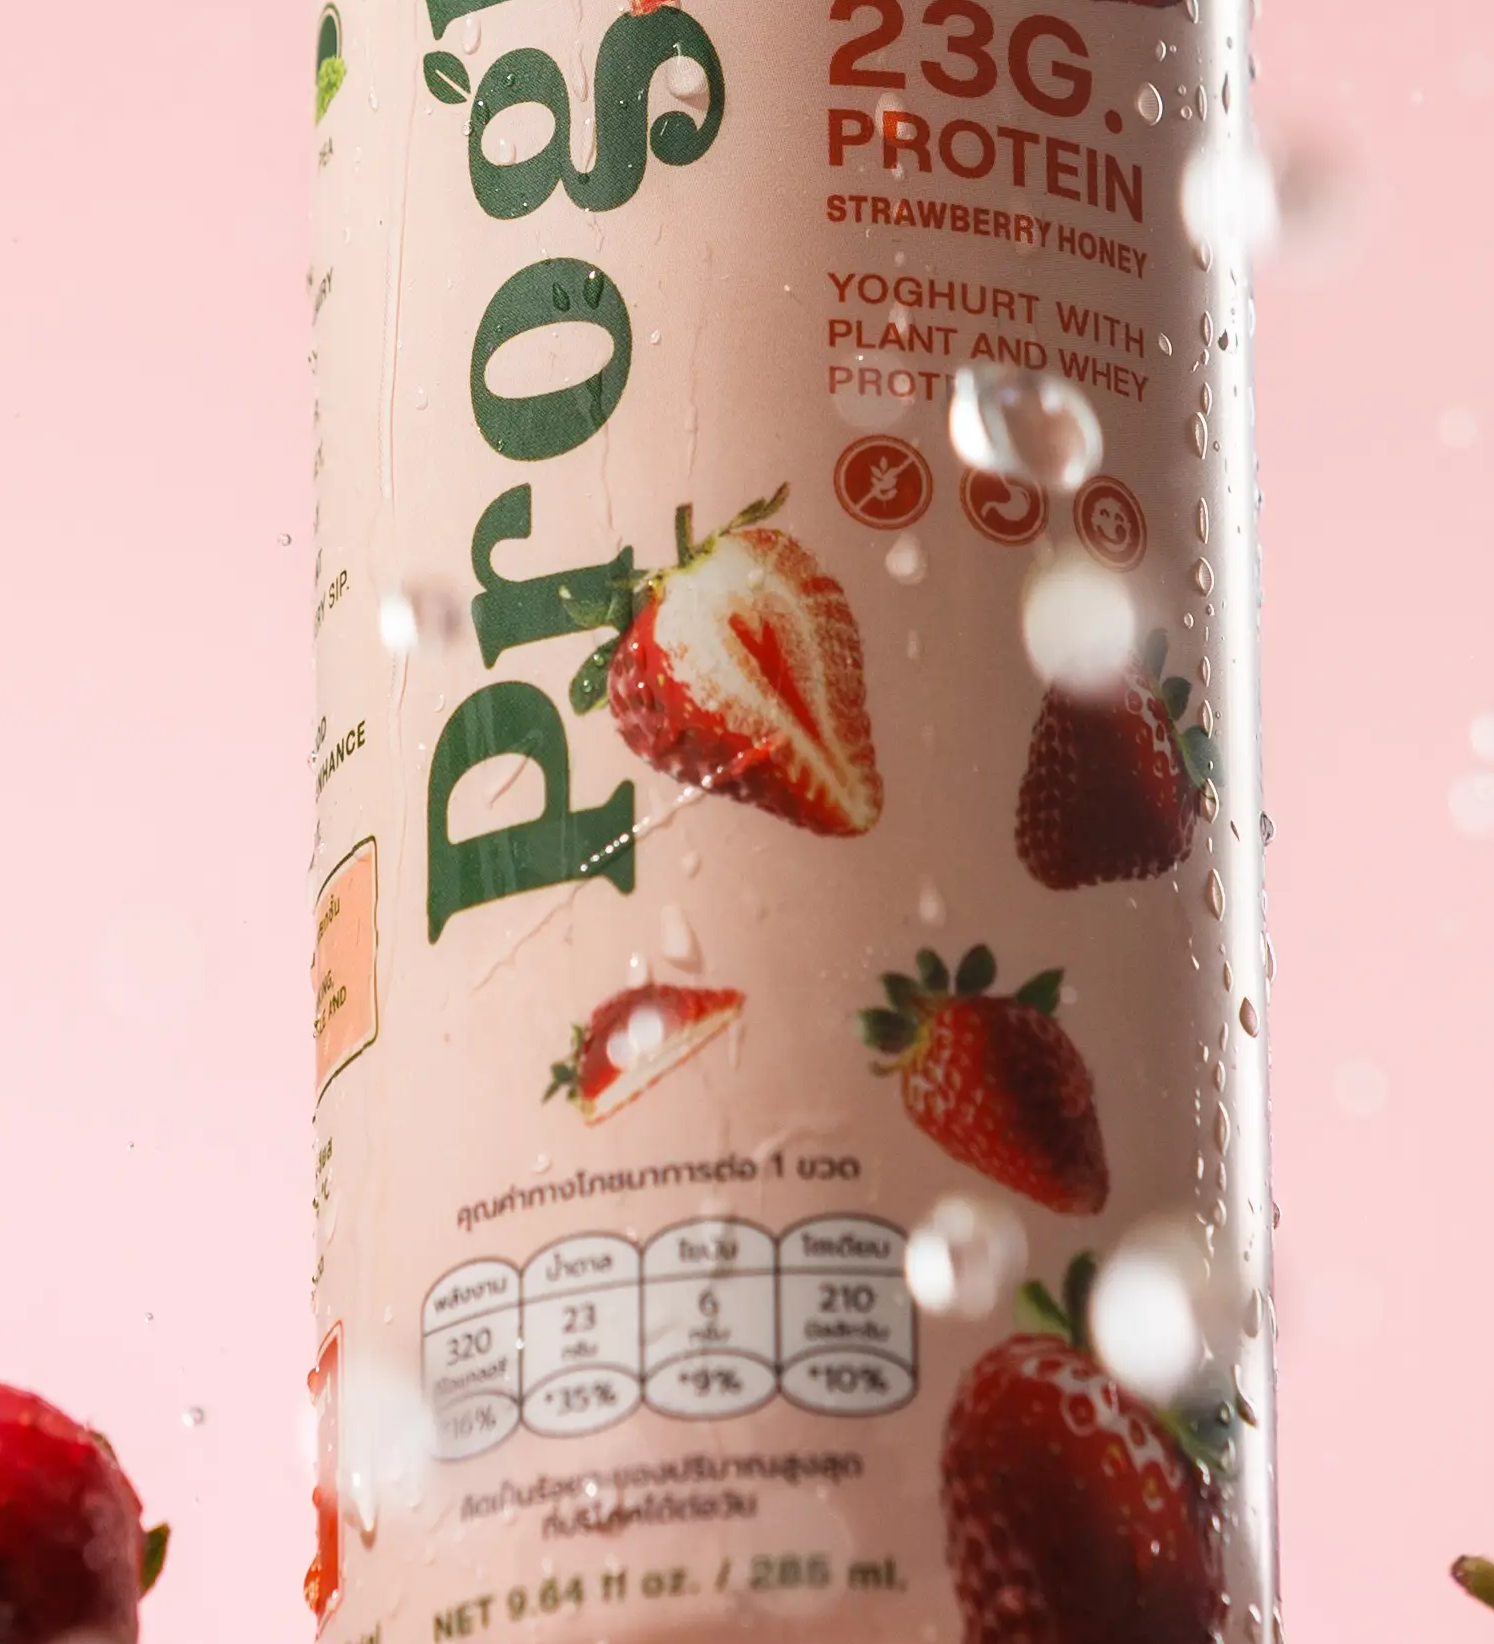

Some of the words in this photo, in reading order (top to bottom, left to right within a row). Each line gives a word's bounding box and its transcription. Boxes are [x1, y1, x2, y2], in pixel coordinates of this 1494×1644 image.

[827, 108, 1144, 224] PROTEIN
[826, 194, 1051, 248] STRAWBERRY
[1057, 223, 1148, 280] HONEY
[827, 272, 1040, 325] YOGHURT
[1055, 301, 1145, 360] WITH
[828, 319, 958, 356] PLANT
[970, 332, 1047, 371] AND
[1058, 348, 1149, 403] WHEY
[828, 365, 957, 403] PROT
[328, 569, 350, 610] SIP.
[315, 719, 367, 805] NHANCE
[771, 1153, 785, 1179] 1
[797, 1154, 861, 1183] ขวด
[562, 1300, 598, 1335] 23
[698, 1287, 719, 1318] 6
[817, 1283, 876, 1314] 210
[445, 1326, 493, 1367] 320
[507, 1573, 586, 1623] 9.64
[641, 1565, 701, 1599] oz.
[714, 1556, 732, 1592] /
[846, 1556, 909, 1593] ml.
